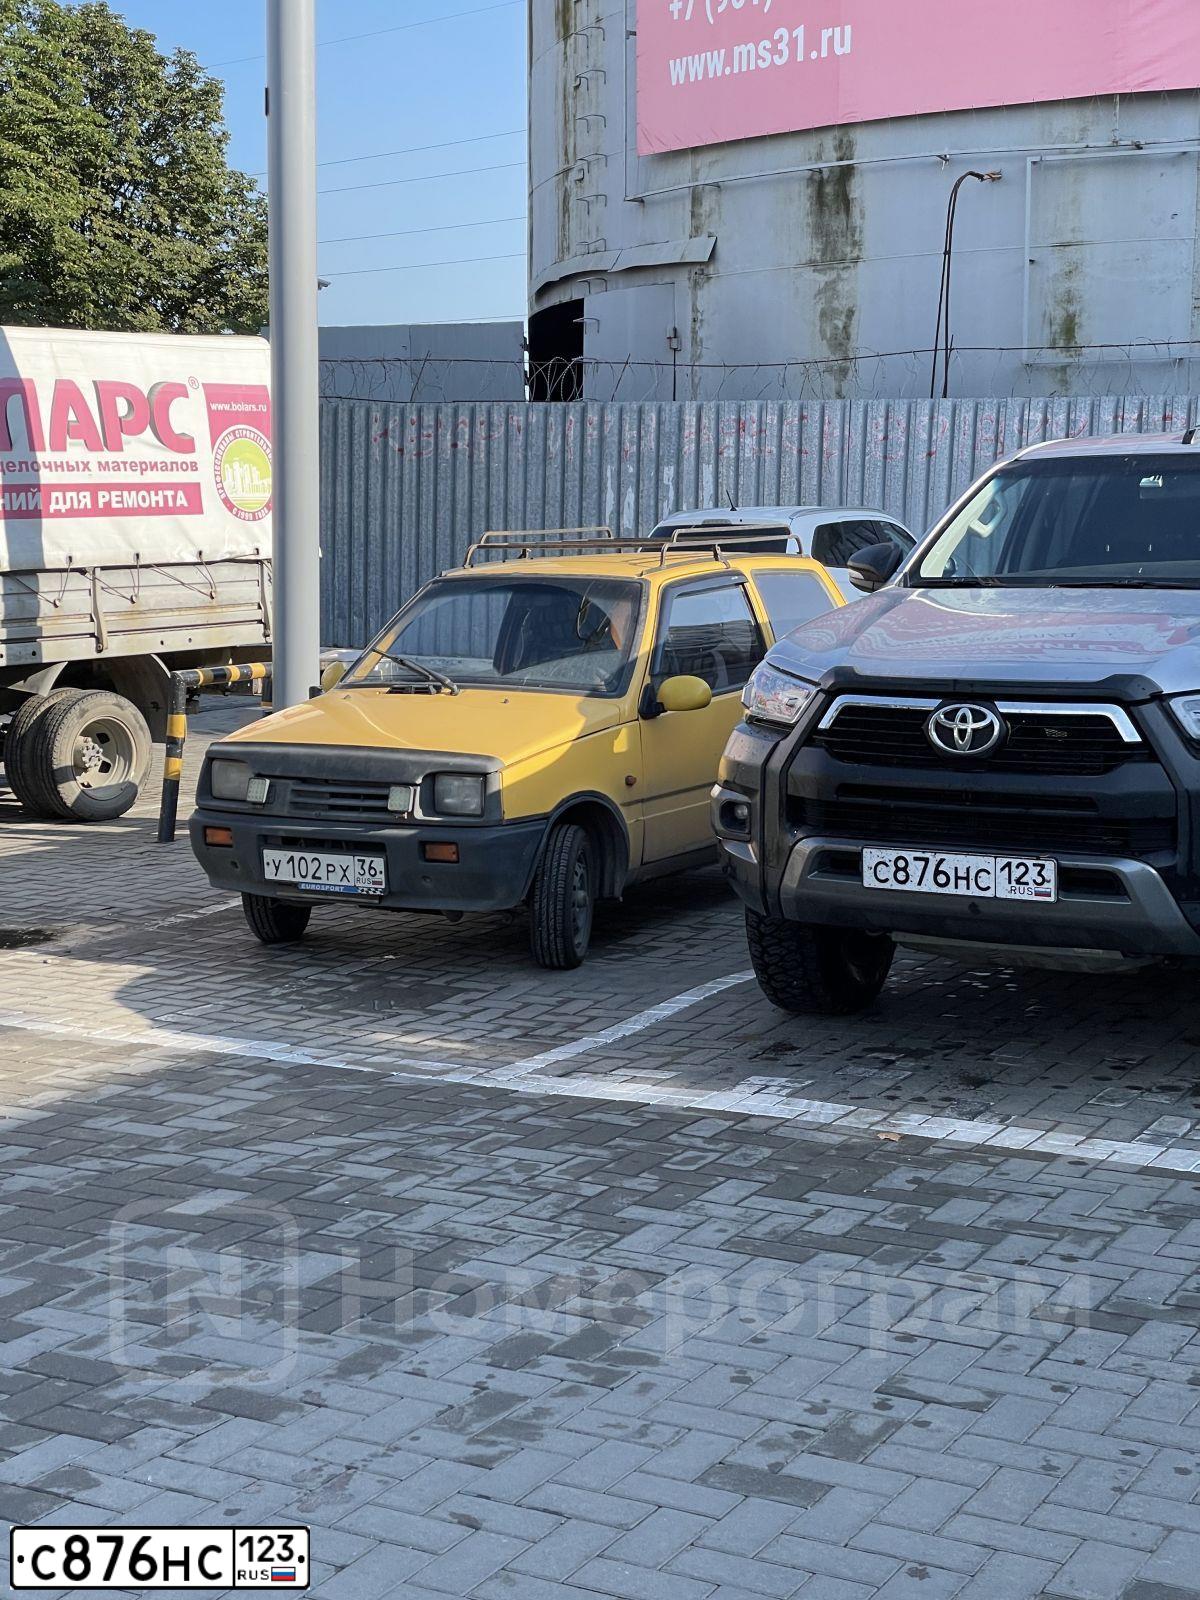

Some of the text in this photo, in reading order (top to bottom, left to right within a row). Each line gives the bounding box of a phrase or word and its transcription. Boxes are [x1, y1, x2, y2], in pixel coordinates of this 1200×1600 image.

[669, 24, 852, 86] www.ms31.ru
[209, 401, 267, 412] www.bolars.ru
[97, 459, 199, 476] материалов
[49, 490, 92, 512] ДЛЯ
[97, 489, 189, 509] РЕМОНТА
[357, 858, 377, 878] 36
[873, 855, 1047, 892] С876НС 123
[301, 882, 344, 892] EUROSPORT
[356, 877, 372, 885] RUS
[1010, 885, 1034, 897] RUS
